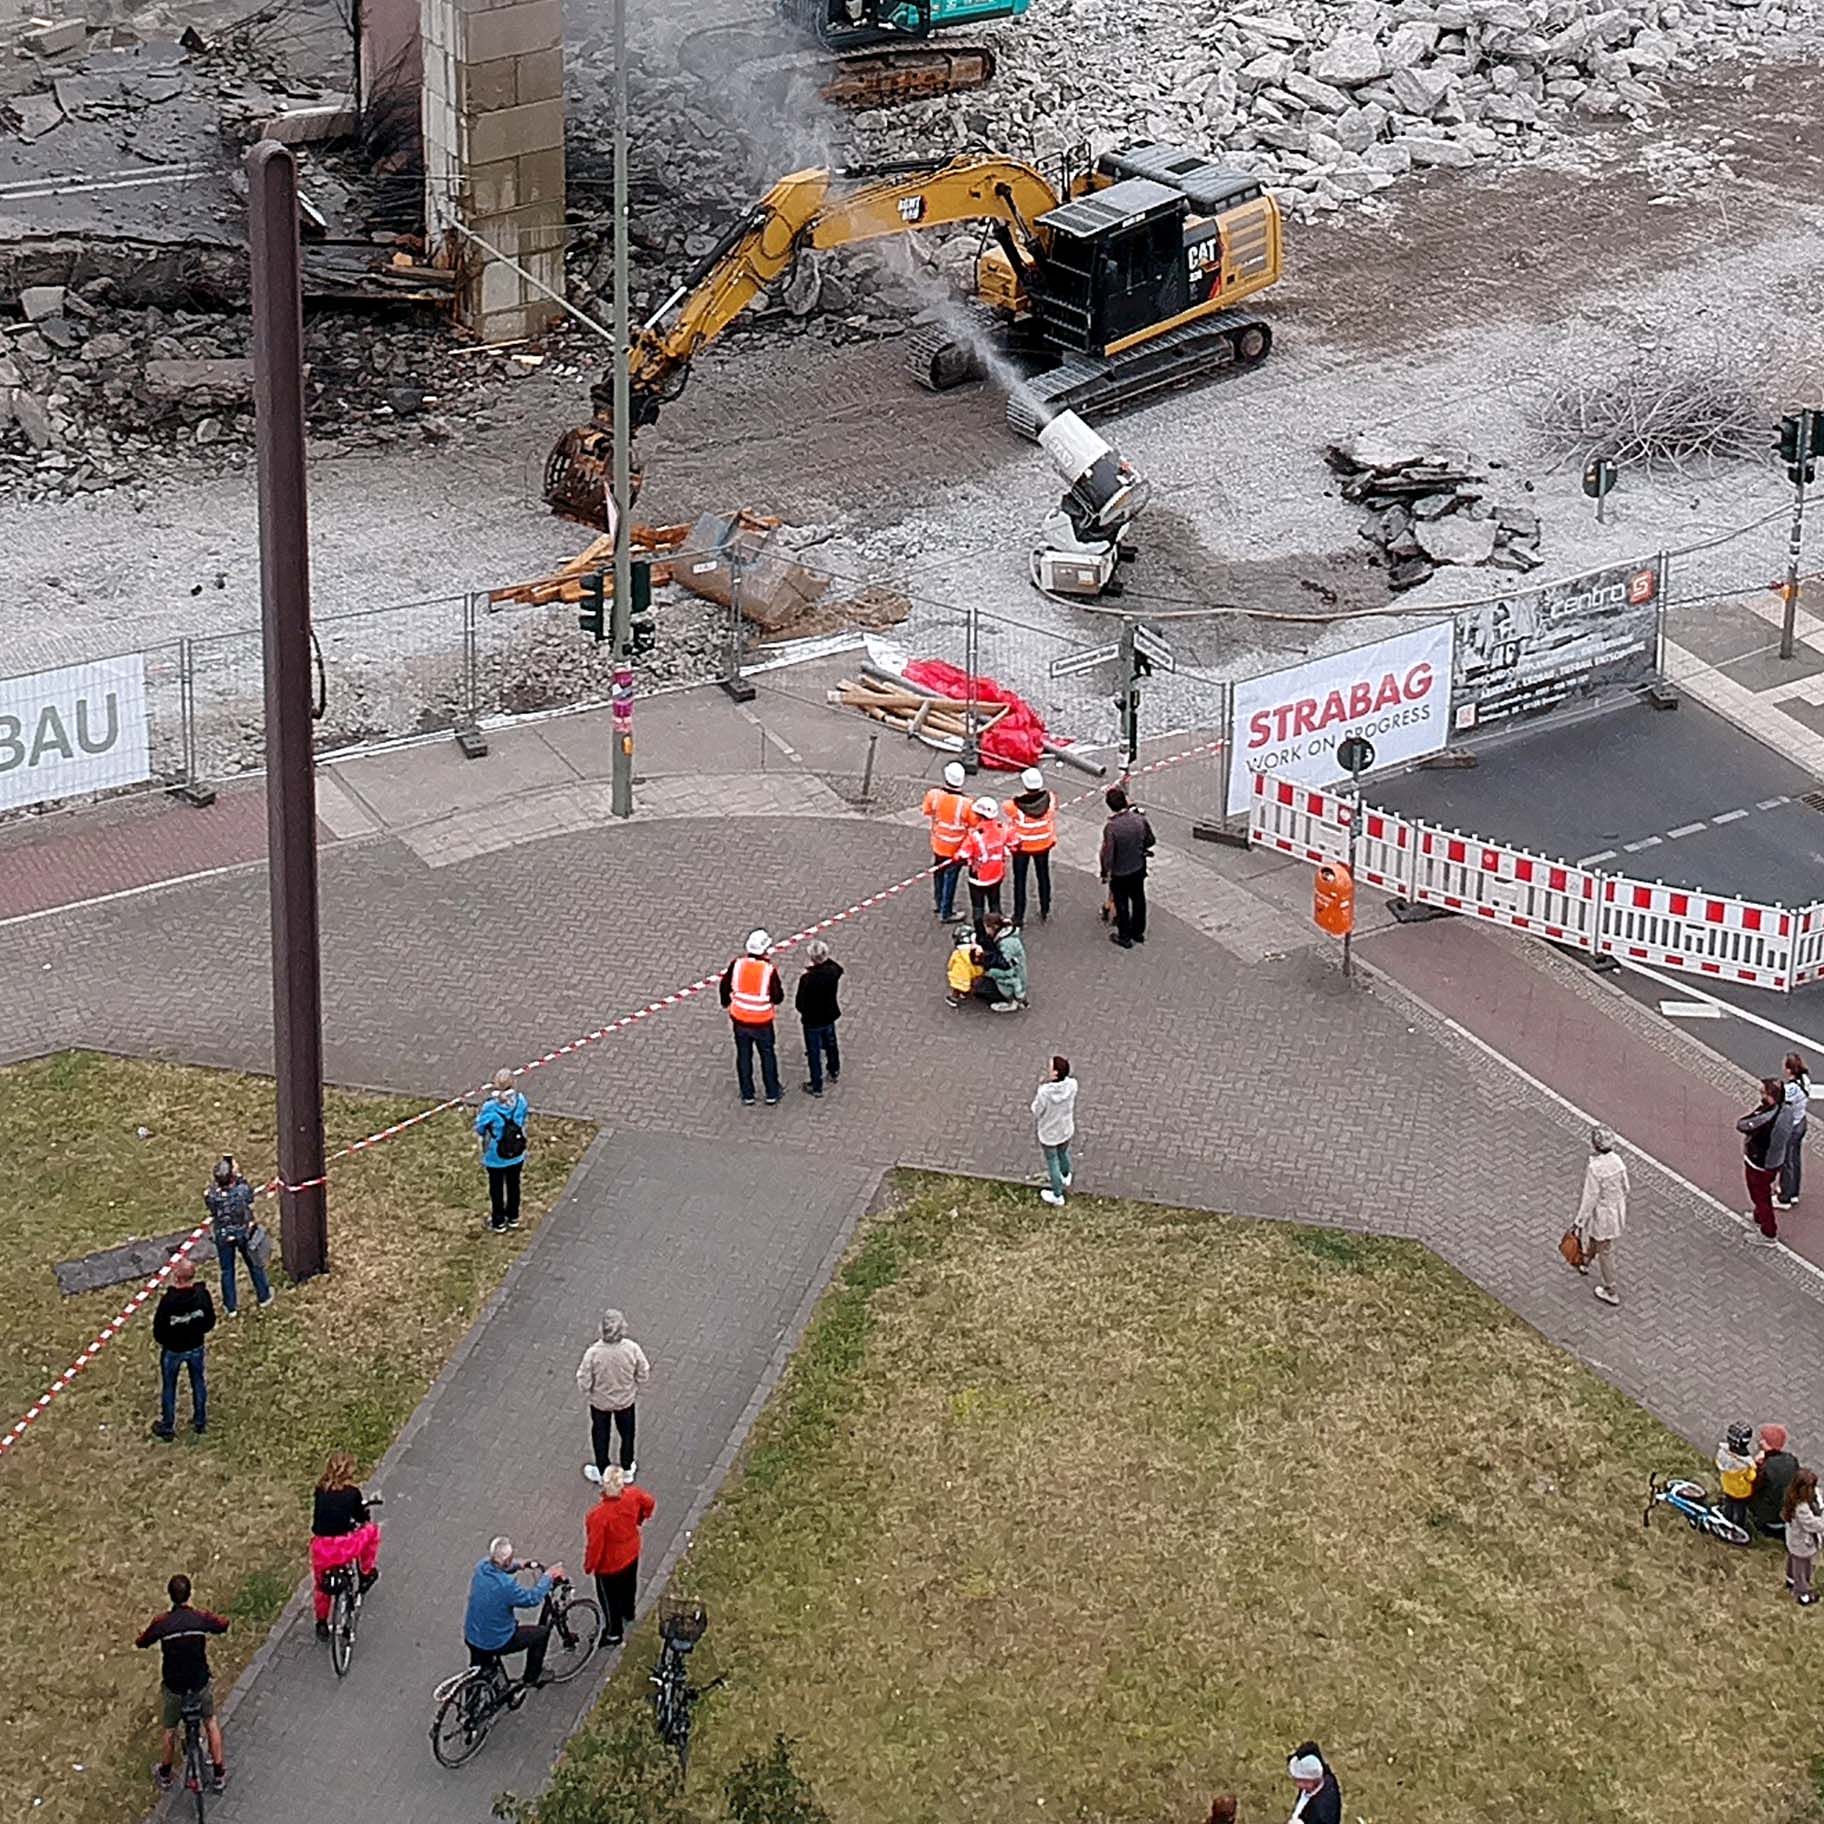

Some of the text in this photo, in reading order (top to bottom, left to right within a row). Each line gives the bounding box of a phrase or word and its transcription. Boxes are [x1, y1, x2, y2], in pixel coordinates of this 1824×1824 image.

[1188, 238, 1216, 270] CAT
[1550, 583, 1626, 619] centro
[1248, 662, 1433, 749] STRABAG
[1246, 704, 1431, 773] WORK ON PROGRESS
